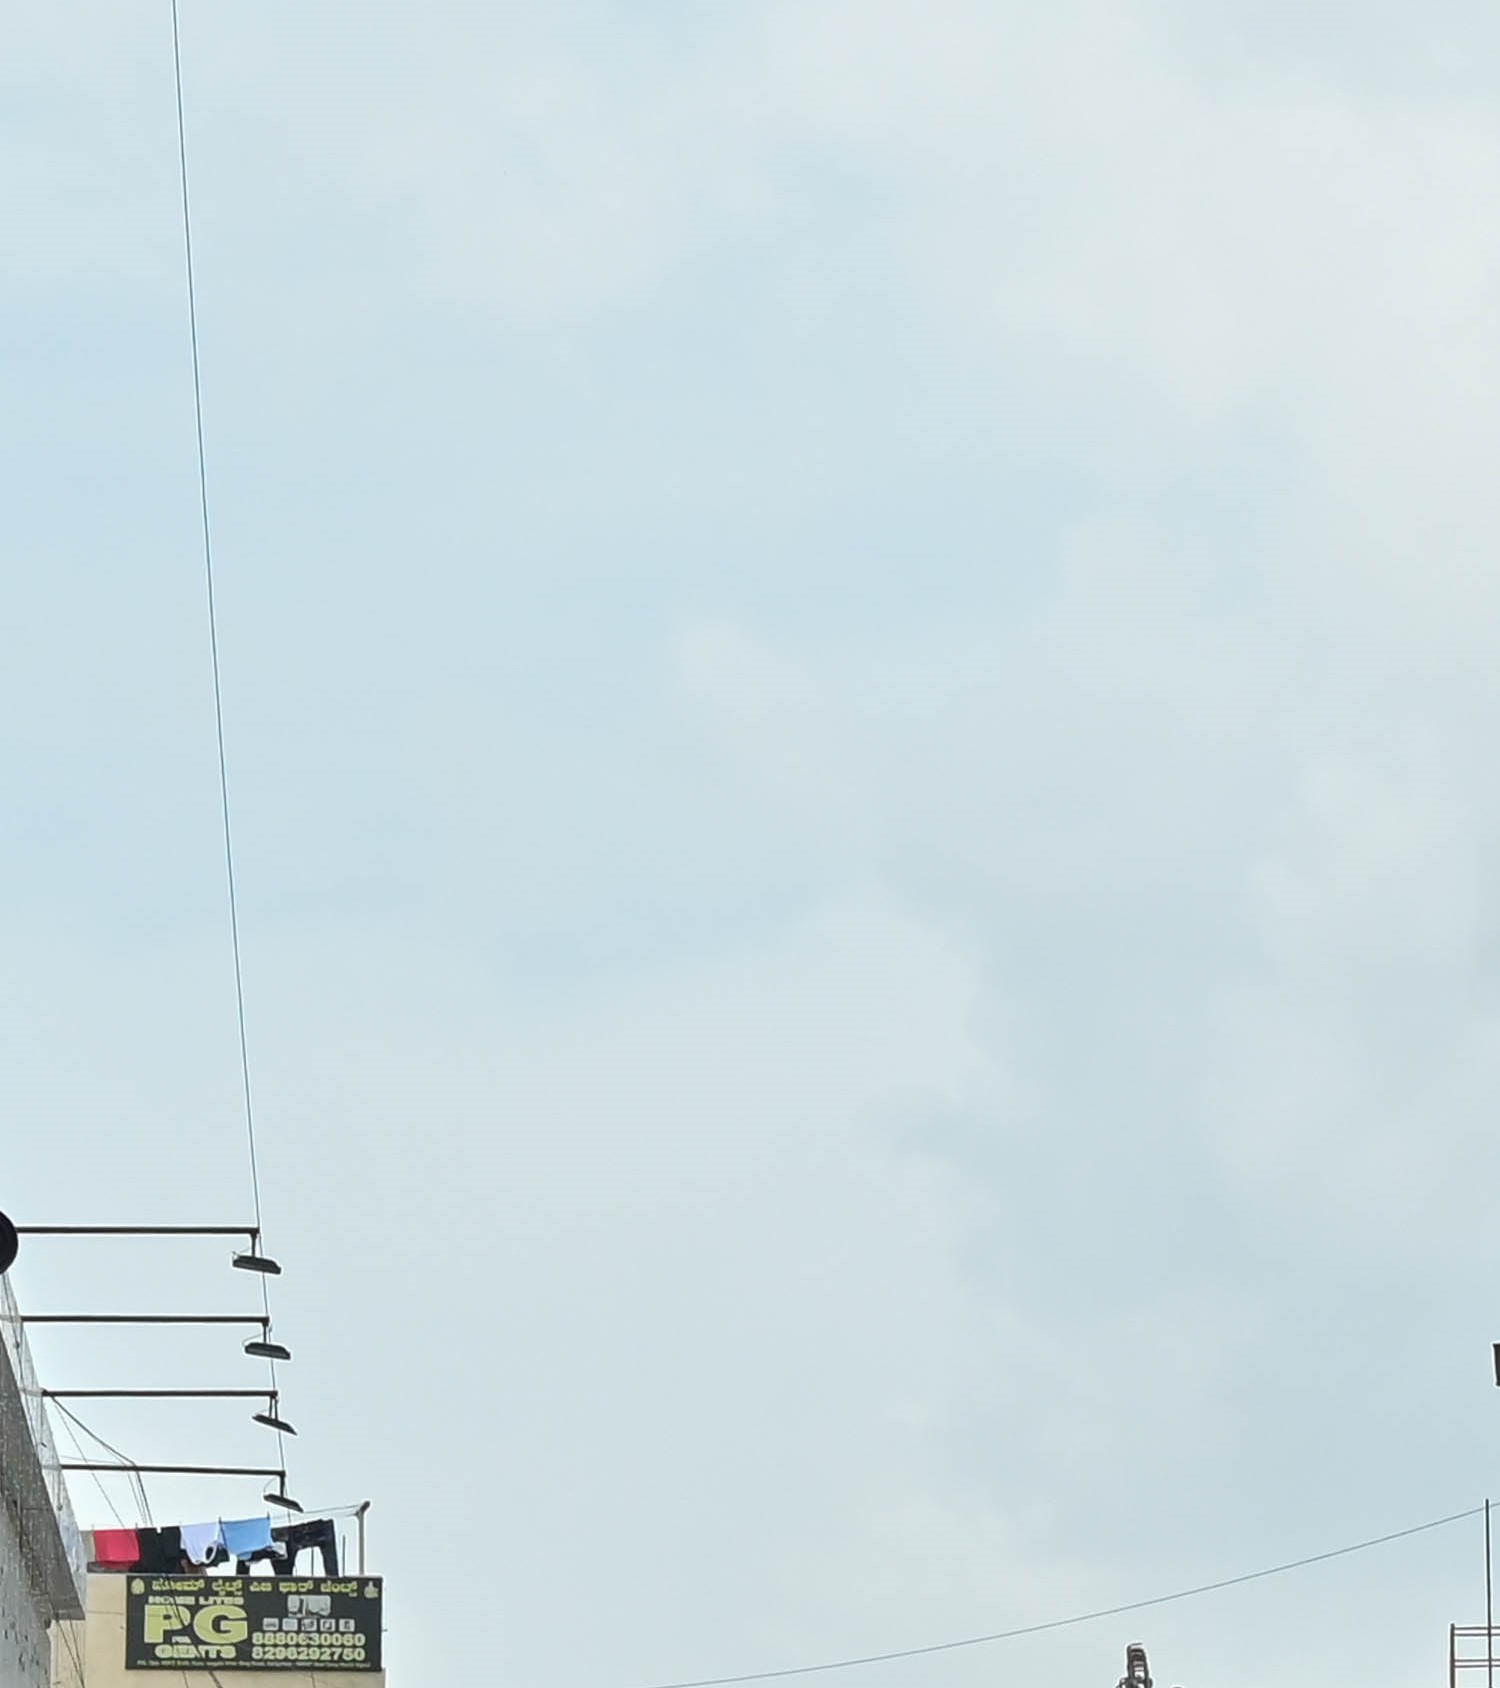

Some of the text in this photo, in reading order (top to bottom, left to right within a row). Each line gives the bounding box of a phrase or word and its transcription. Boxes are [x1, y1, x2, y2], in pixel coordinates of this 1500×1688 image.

[143, 1604, 248, 1644] PG
[154, 1645, 236, 1659] GENTS
[251, 1646, 366, 1661] 8296292750
